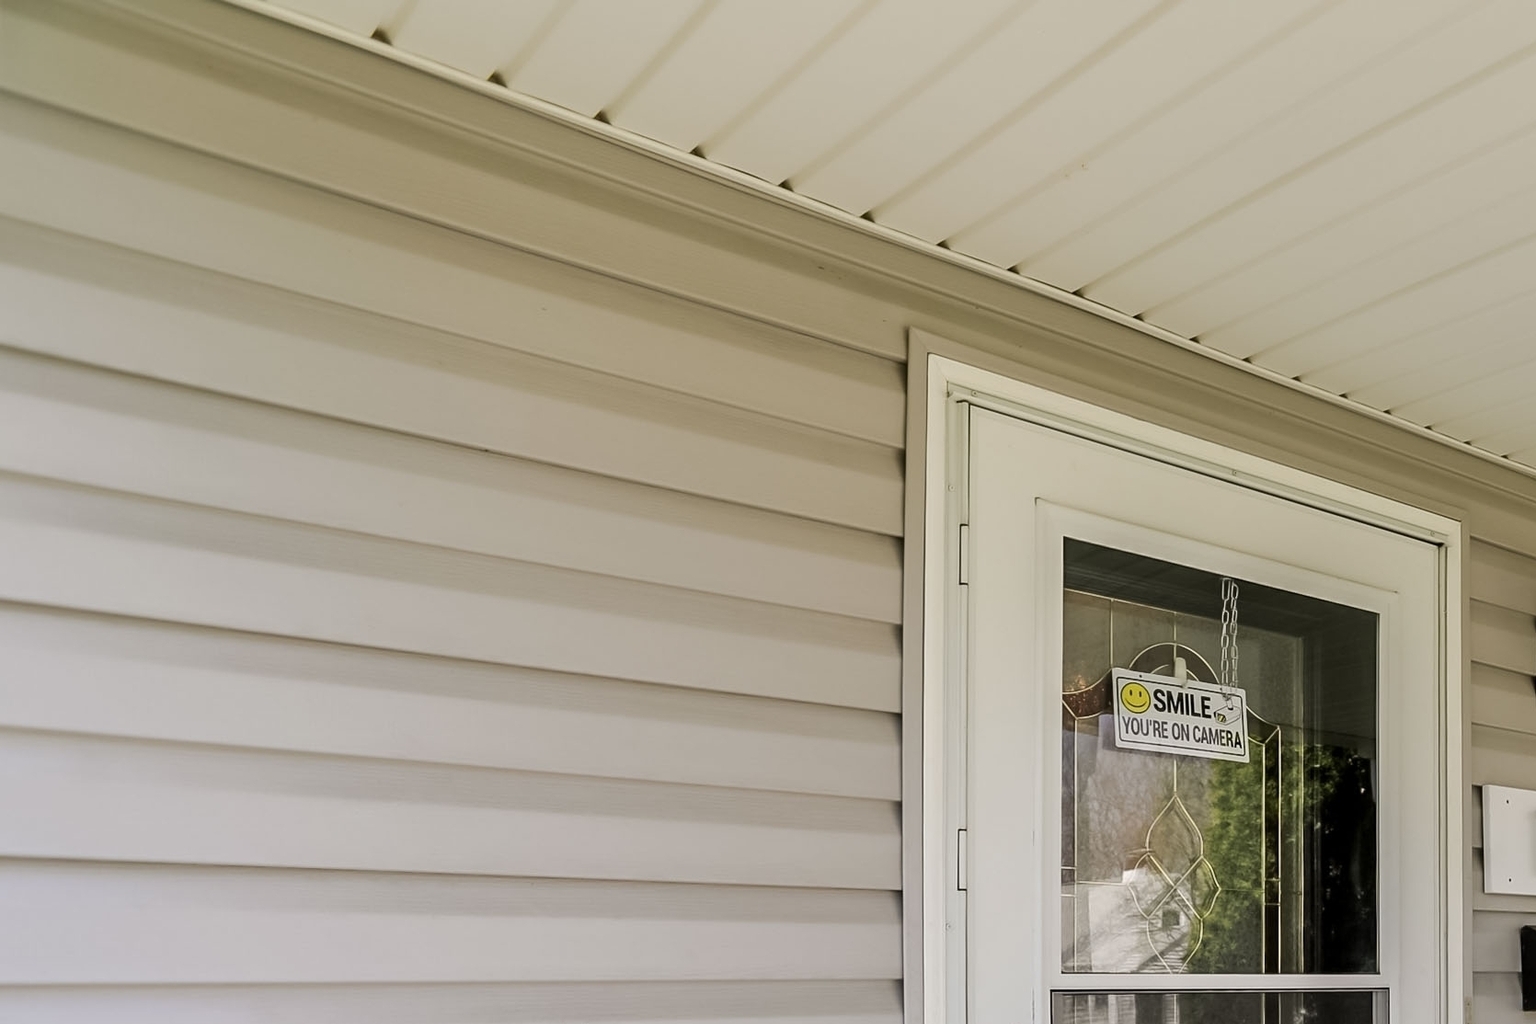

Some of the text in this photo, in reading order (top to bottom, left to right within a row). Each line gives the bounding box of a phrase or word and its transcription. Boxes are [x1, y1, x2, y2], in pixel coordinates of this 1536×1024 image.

[1153, 688, 1212, 719] SMILE
[1122, 716, 1243, 749] YOU'RE ON CAMERA
